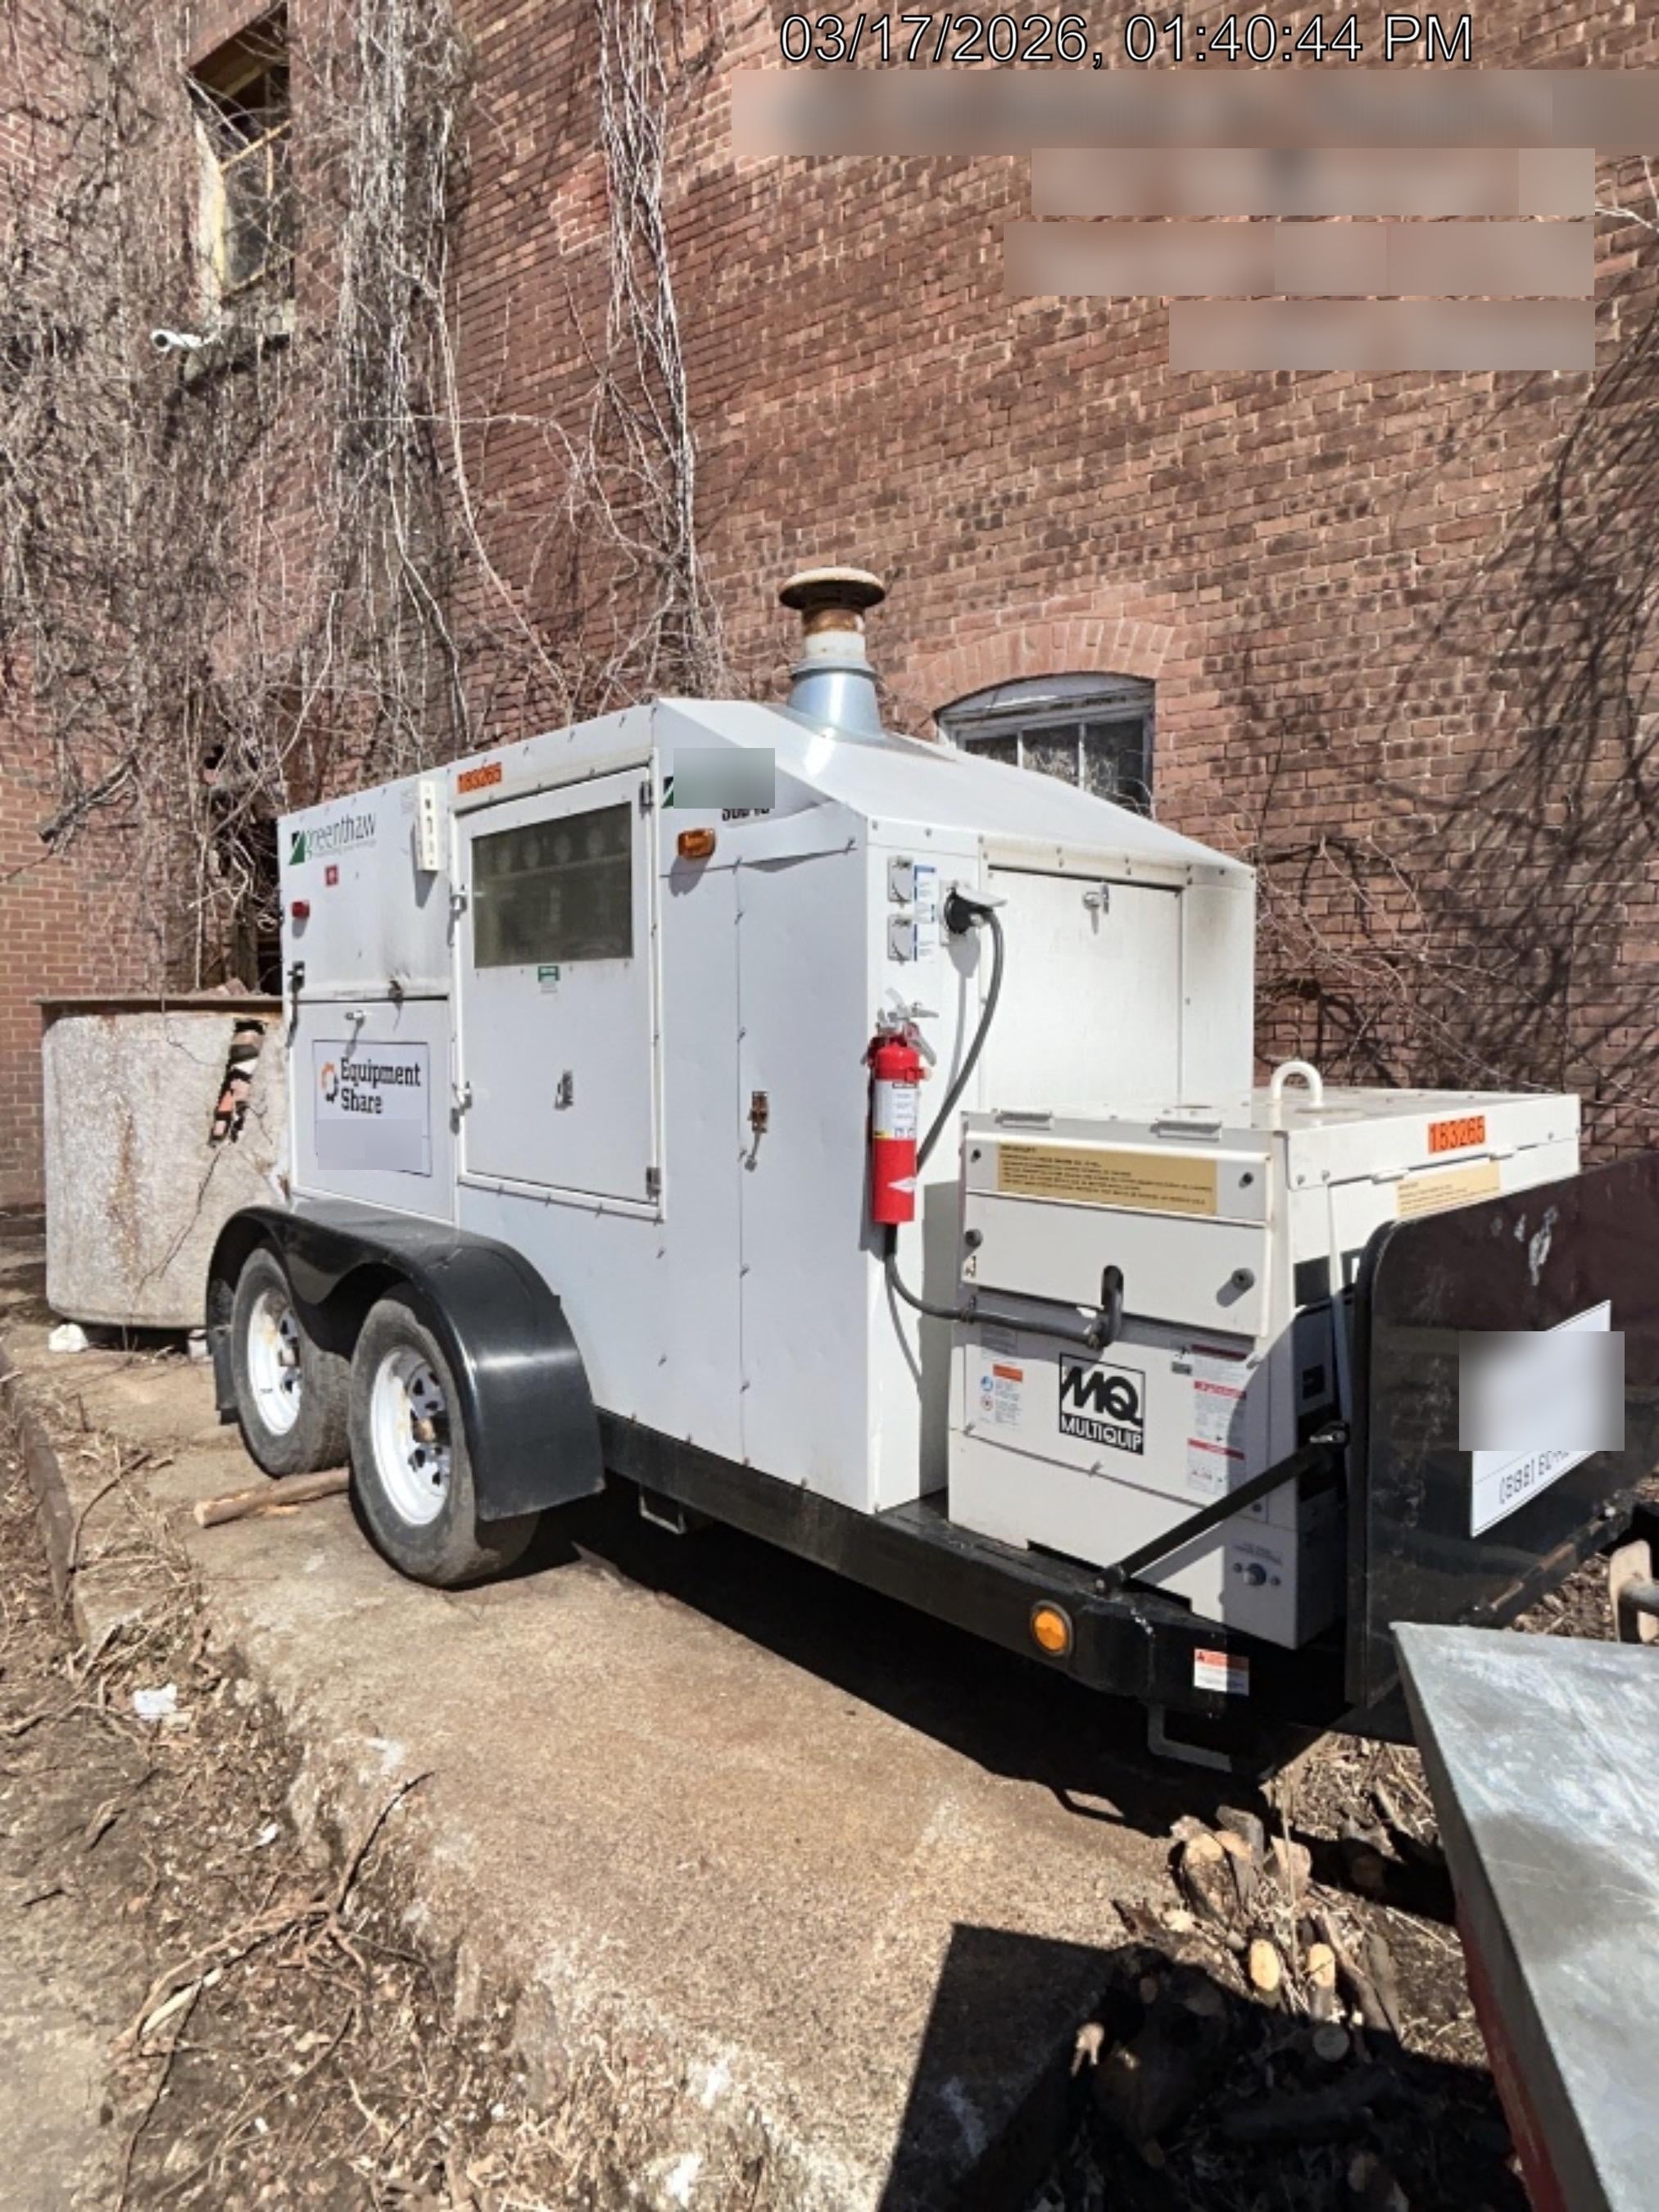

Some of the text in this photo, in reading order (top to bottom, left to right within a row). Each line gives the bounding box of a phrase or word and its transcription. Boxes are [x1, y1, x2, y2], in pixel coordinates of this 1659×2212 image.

[341, 1058, 420, 1089] Equipment
[341, 1088, 383, 1114] Share
[1062, 1366, 1142, 1426] MQ
[1062, 1414, 1142, 1453] MULTIQUIP
